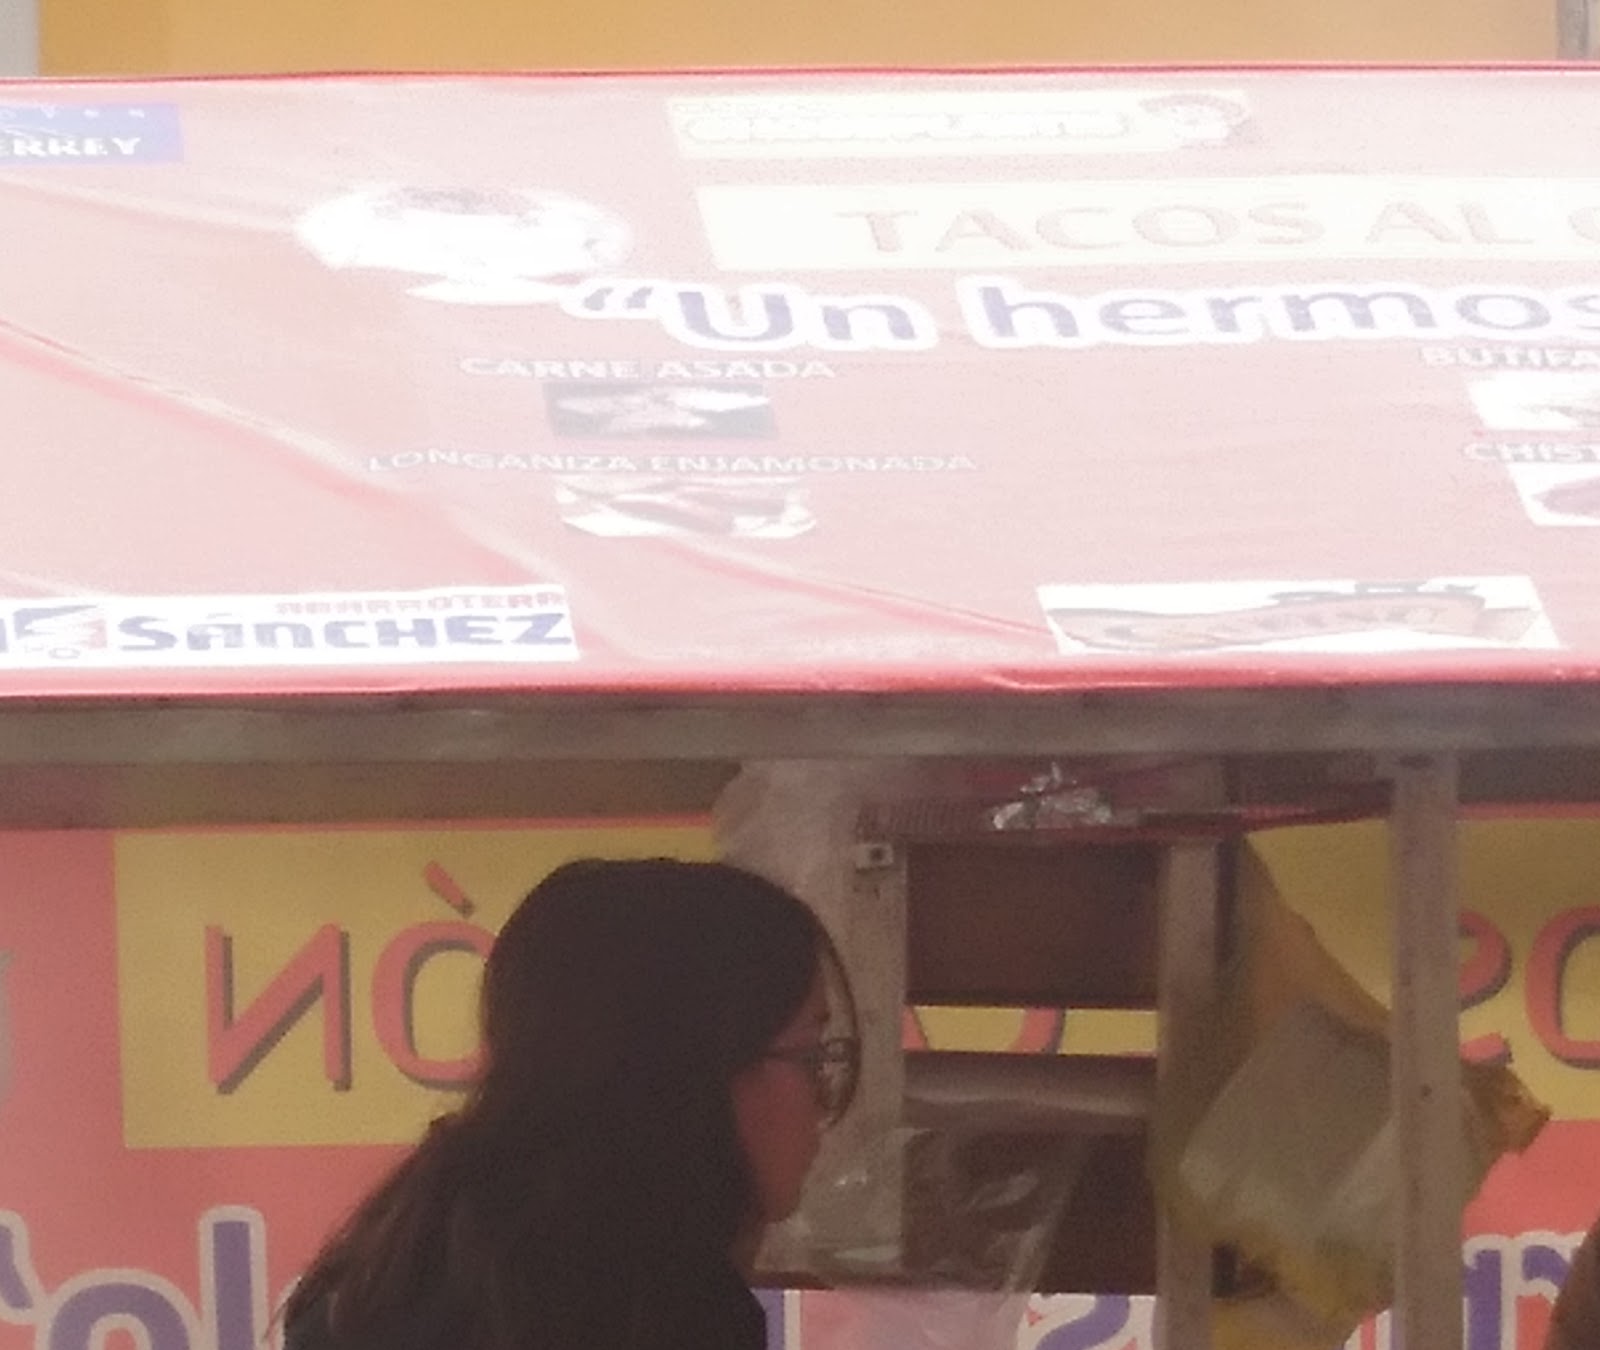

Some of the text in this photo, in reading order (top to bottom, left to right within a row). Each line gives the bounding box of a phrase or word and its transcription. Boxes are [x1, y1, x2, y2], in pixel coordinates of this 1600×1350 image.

[835, 202, 1326, 254] TACOS
[1363, 198, 1532, 247] AL
[458, 356, 837, 379] CARNE ASADA
[367, 448, 980, 474] LONGANIZA ENJAMONADA
